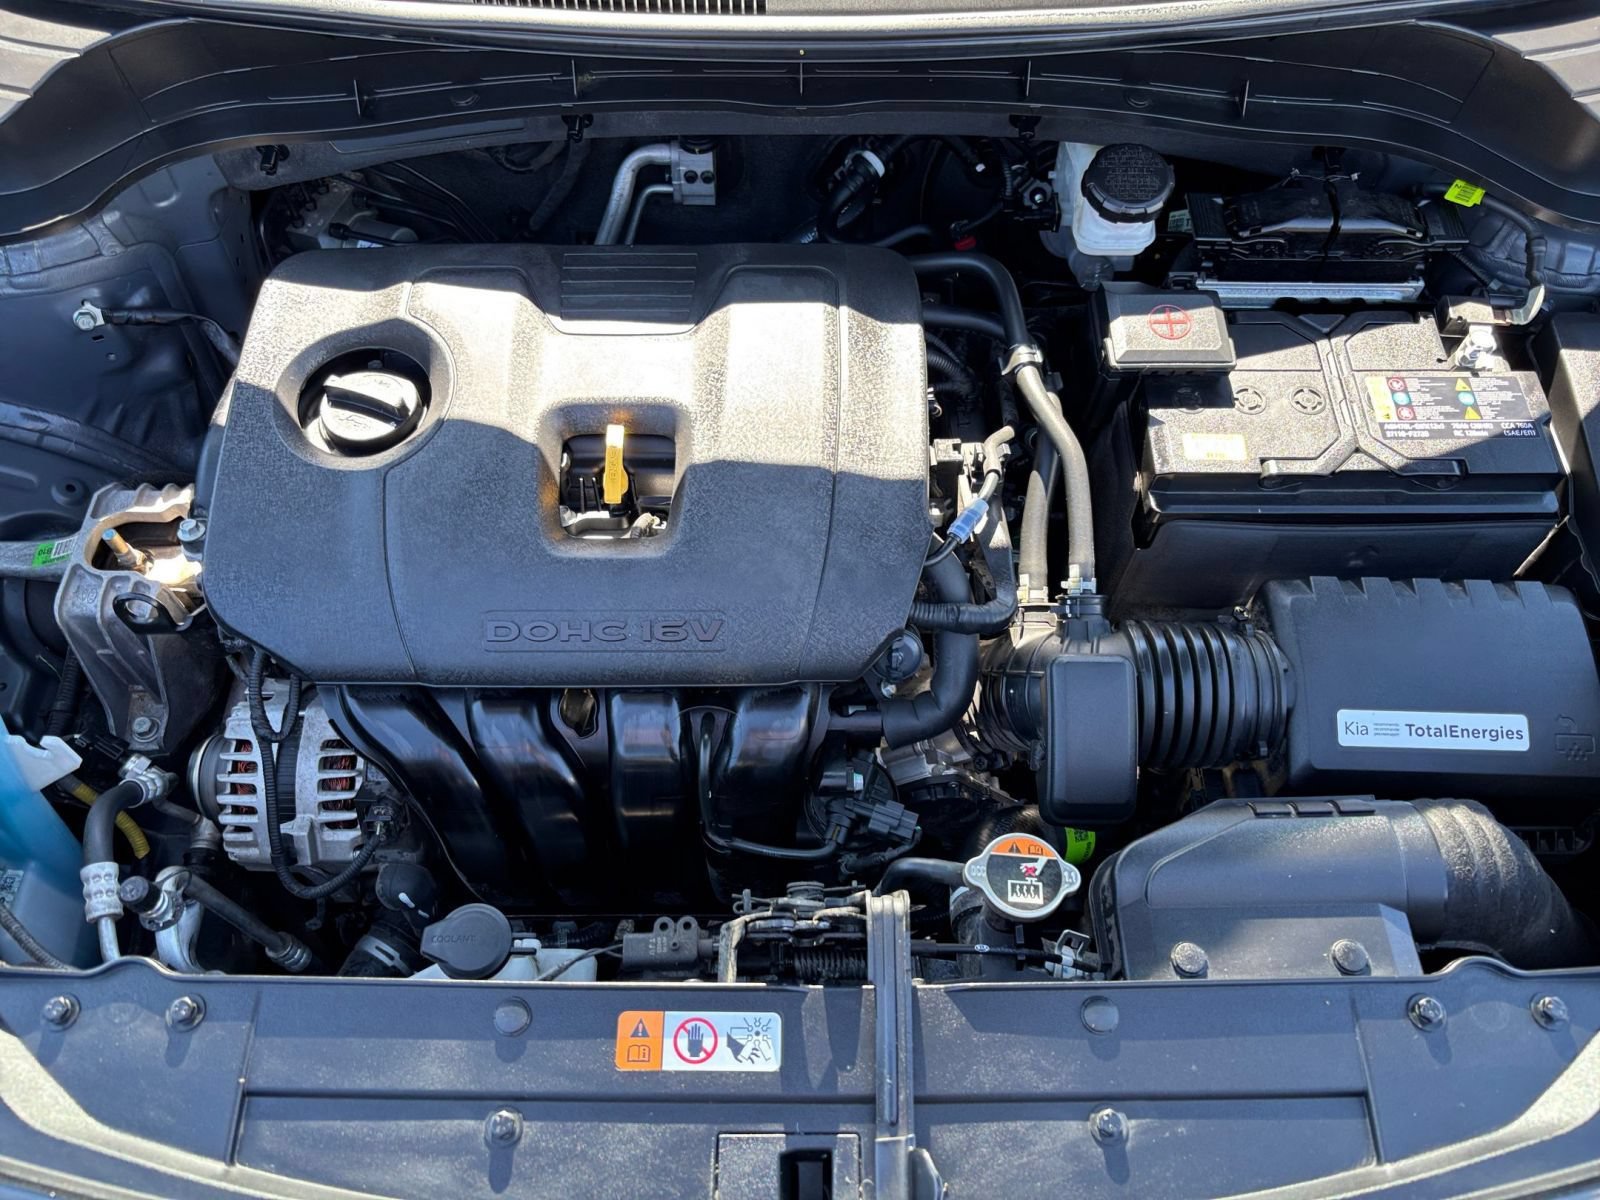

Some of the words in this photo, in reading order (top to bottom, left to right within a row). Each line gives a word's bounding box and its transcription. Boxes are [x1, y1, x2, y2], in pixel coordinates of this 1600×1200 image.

[486, 620, 627, 642] DOHC
[641, 619, 724, 642] 16V
[1344, 721, 1369, 736] Kia
[1405, 723, 1524, 742] TotalEnergies
[431, 934, 476, 944] COOLANT
